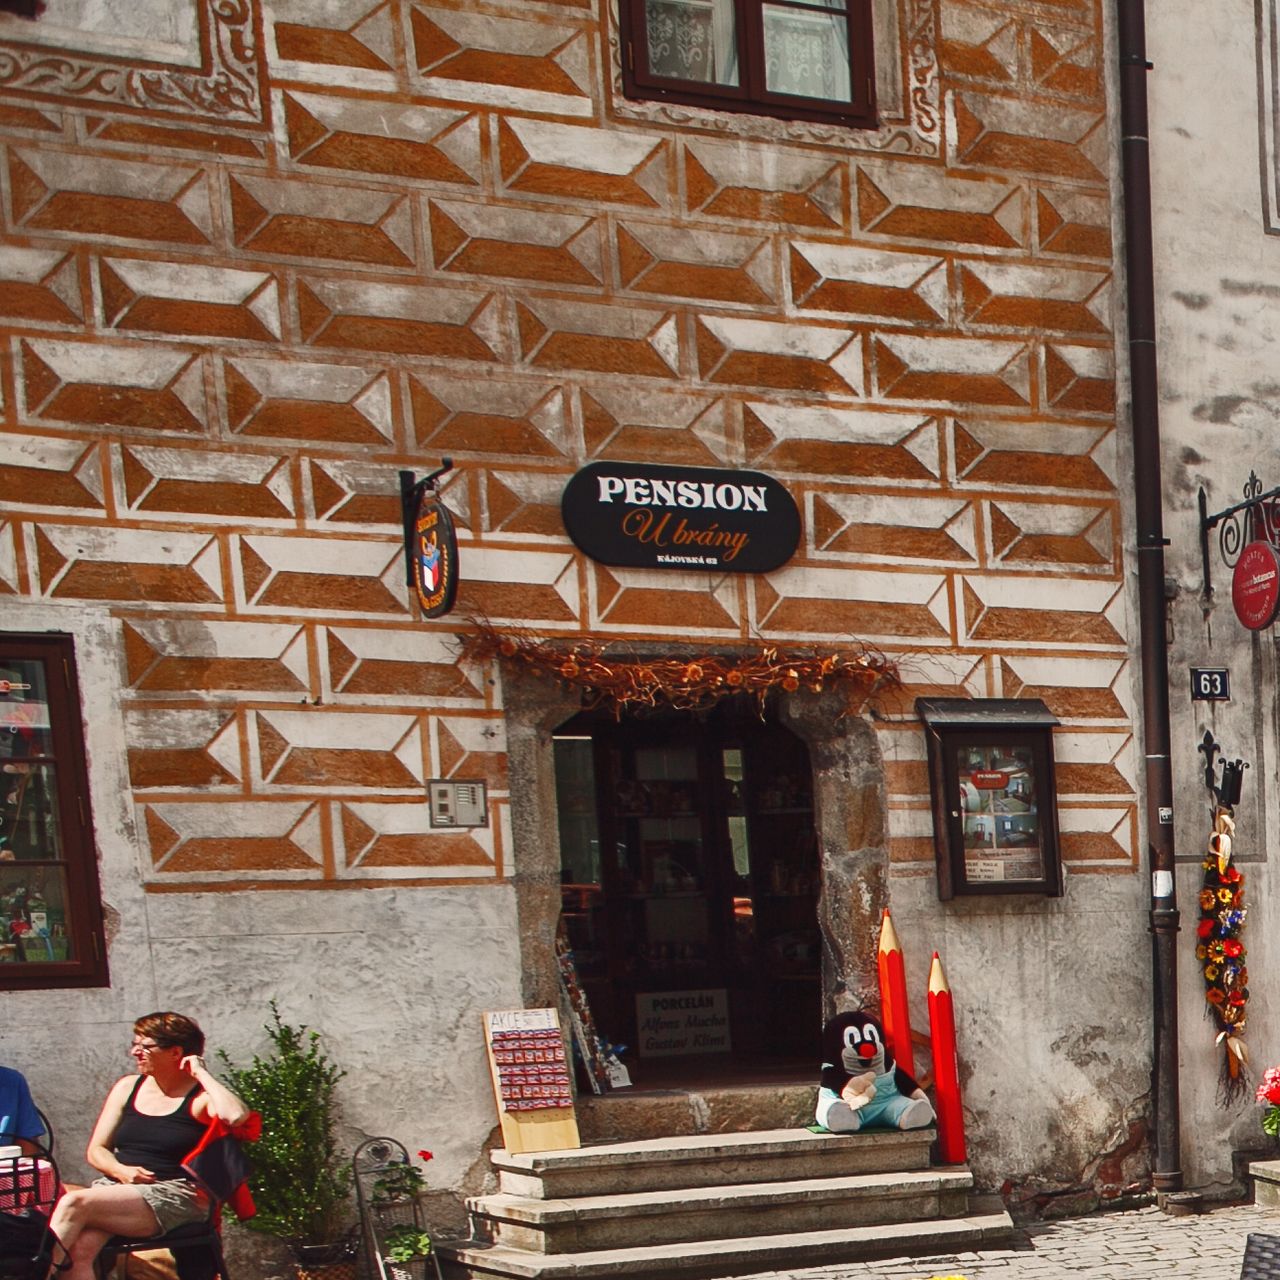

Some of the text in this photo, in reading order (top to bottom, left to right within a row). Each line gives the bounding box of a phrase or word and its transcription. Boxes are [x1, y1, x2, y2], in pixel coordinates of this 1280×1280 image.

[597, 475, 768, 513] PENSION
[622, 508, 750, 561] U brány
[1200, 674, 1221, 695] 63
